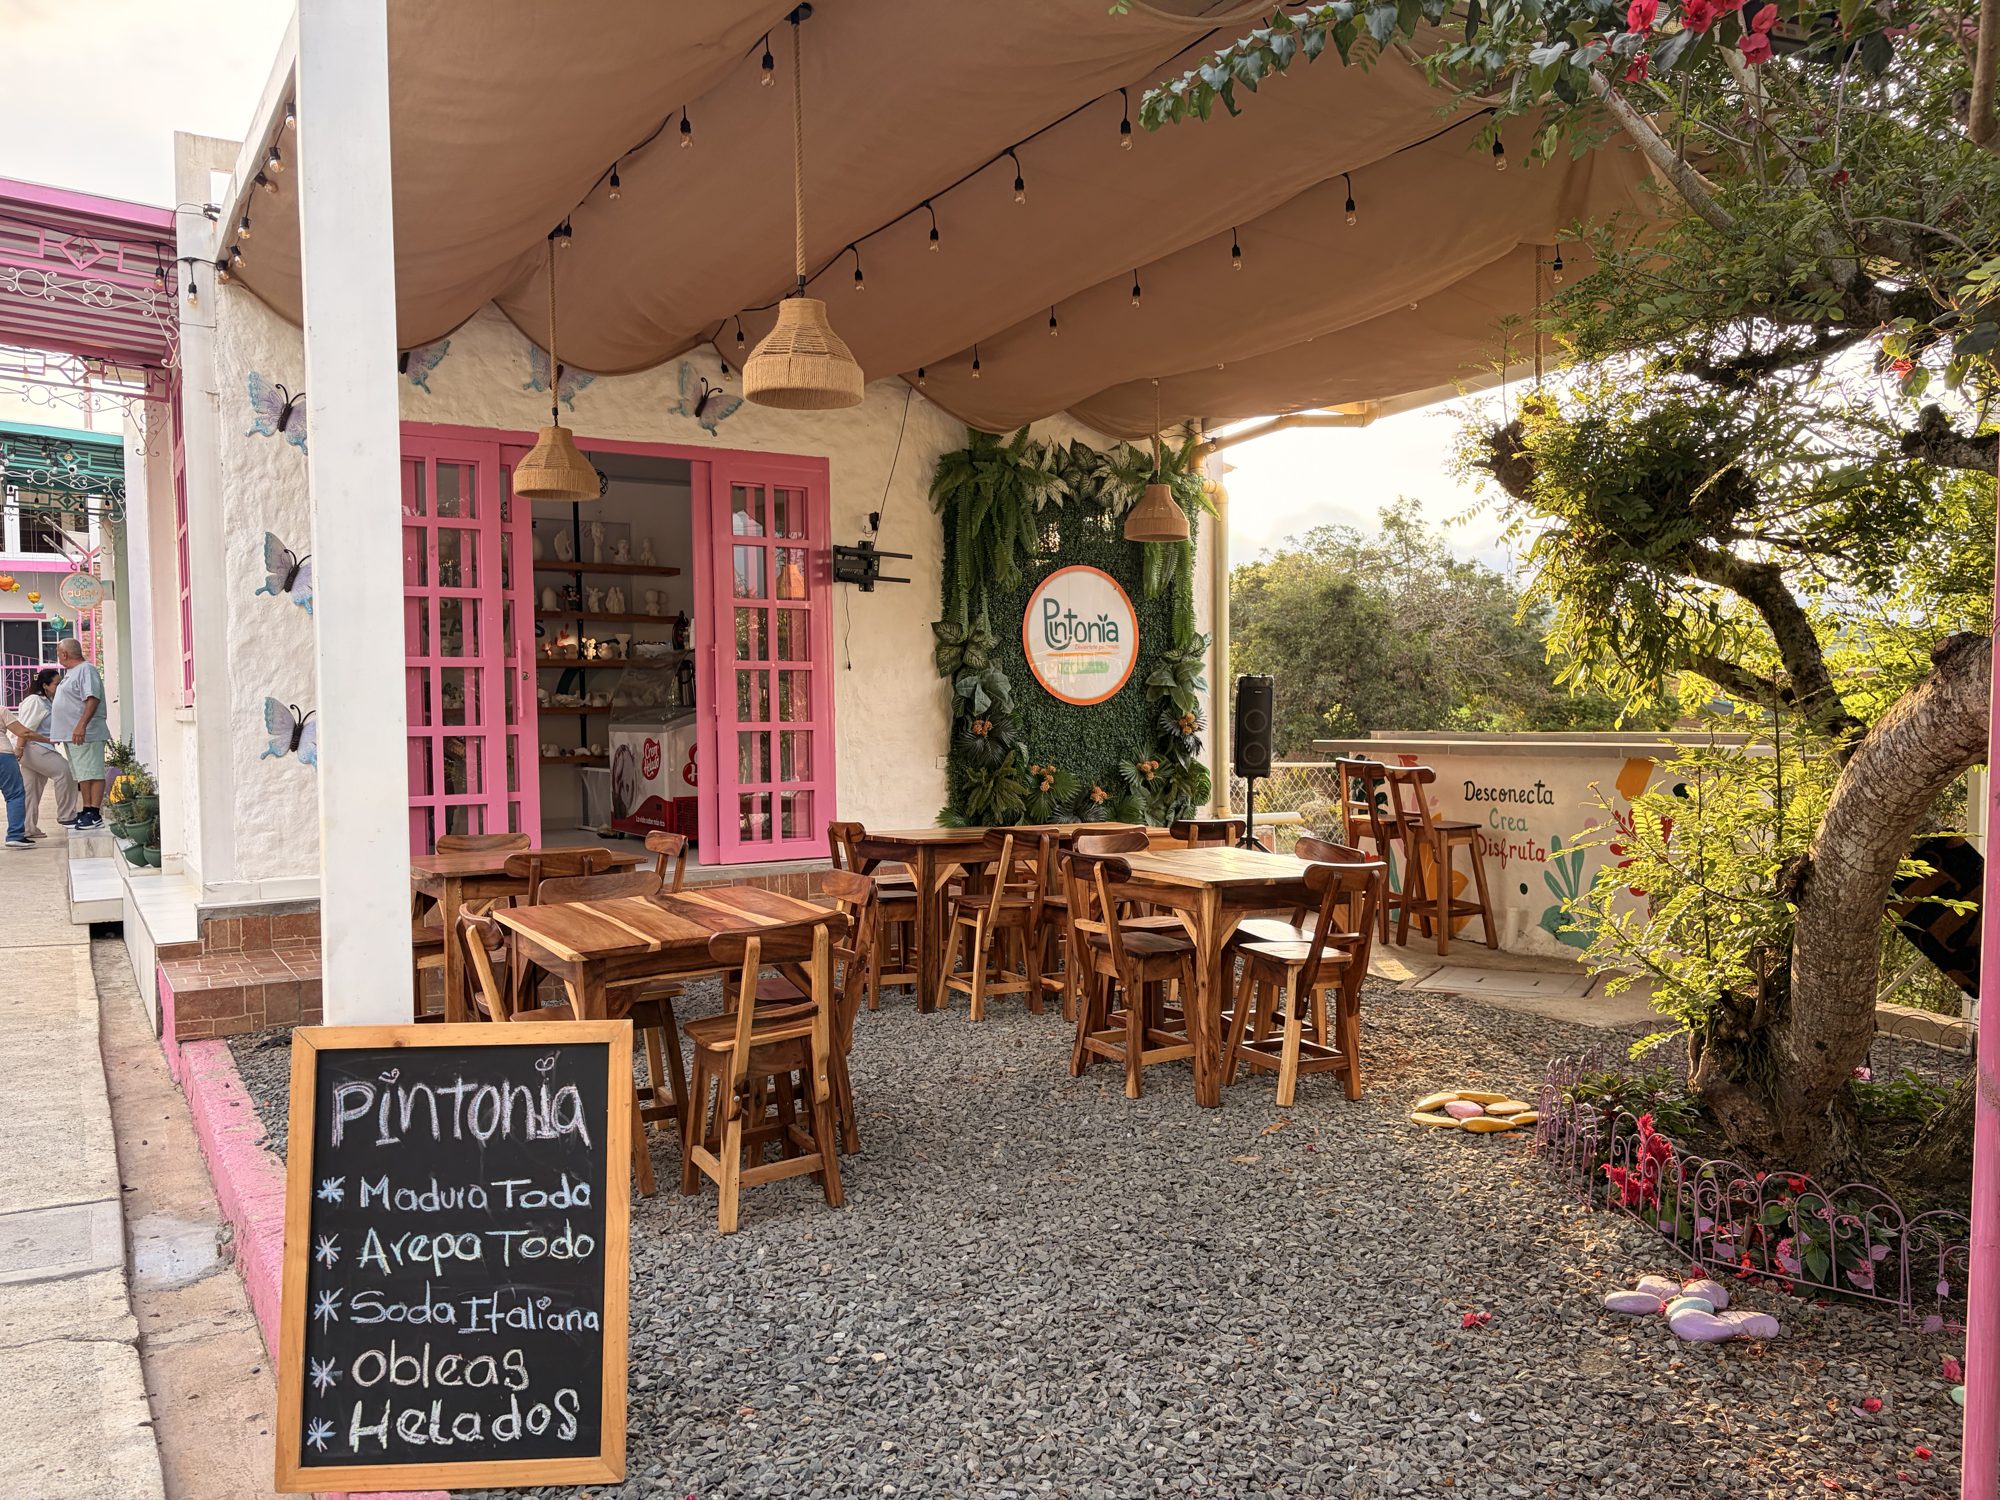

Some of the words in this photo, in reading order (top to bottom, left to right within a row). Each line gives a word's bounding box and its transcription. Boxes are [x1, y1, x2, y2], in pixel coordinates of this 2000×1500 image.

[1043, 598, 1119, 650] Pintonia
[1463, 780, 1555, 805] Desconecta
[1489, 807, 1528, 832] Crea
[332, 1056, 592, 1150] Pintonia
[360, 1174, 487, 1211] Madura
[356, 1227, 483, 1276] Arepa
[485, 1218, 595, 1267] Todo
[350, 1280, 457, 1324] Soda
[458, 1290, 600, 1334] Italiana
[352, 1339, 530, 1391] Obleas
